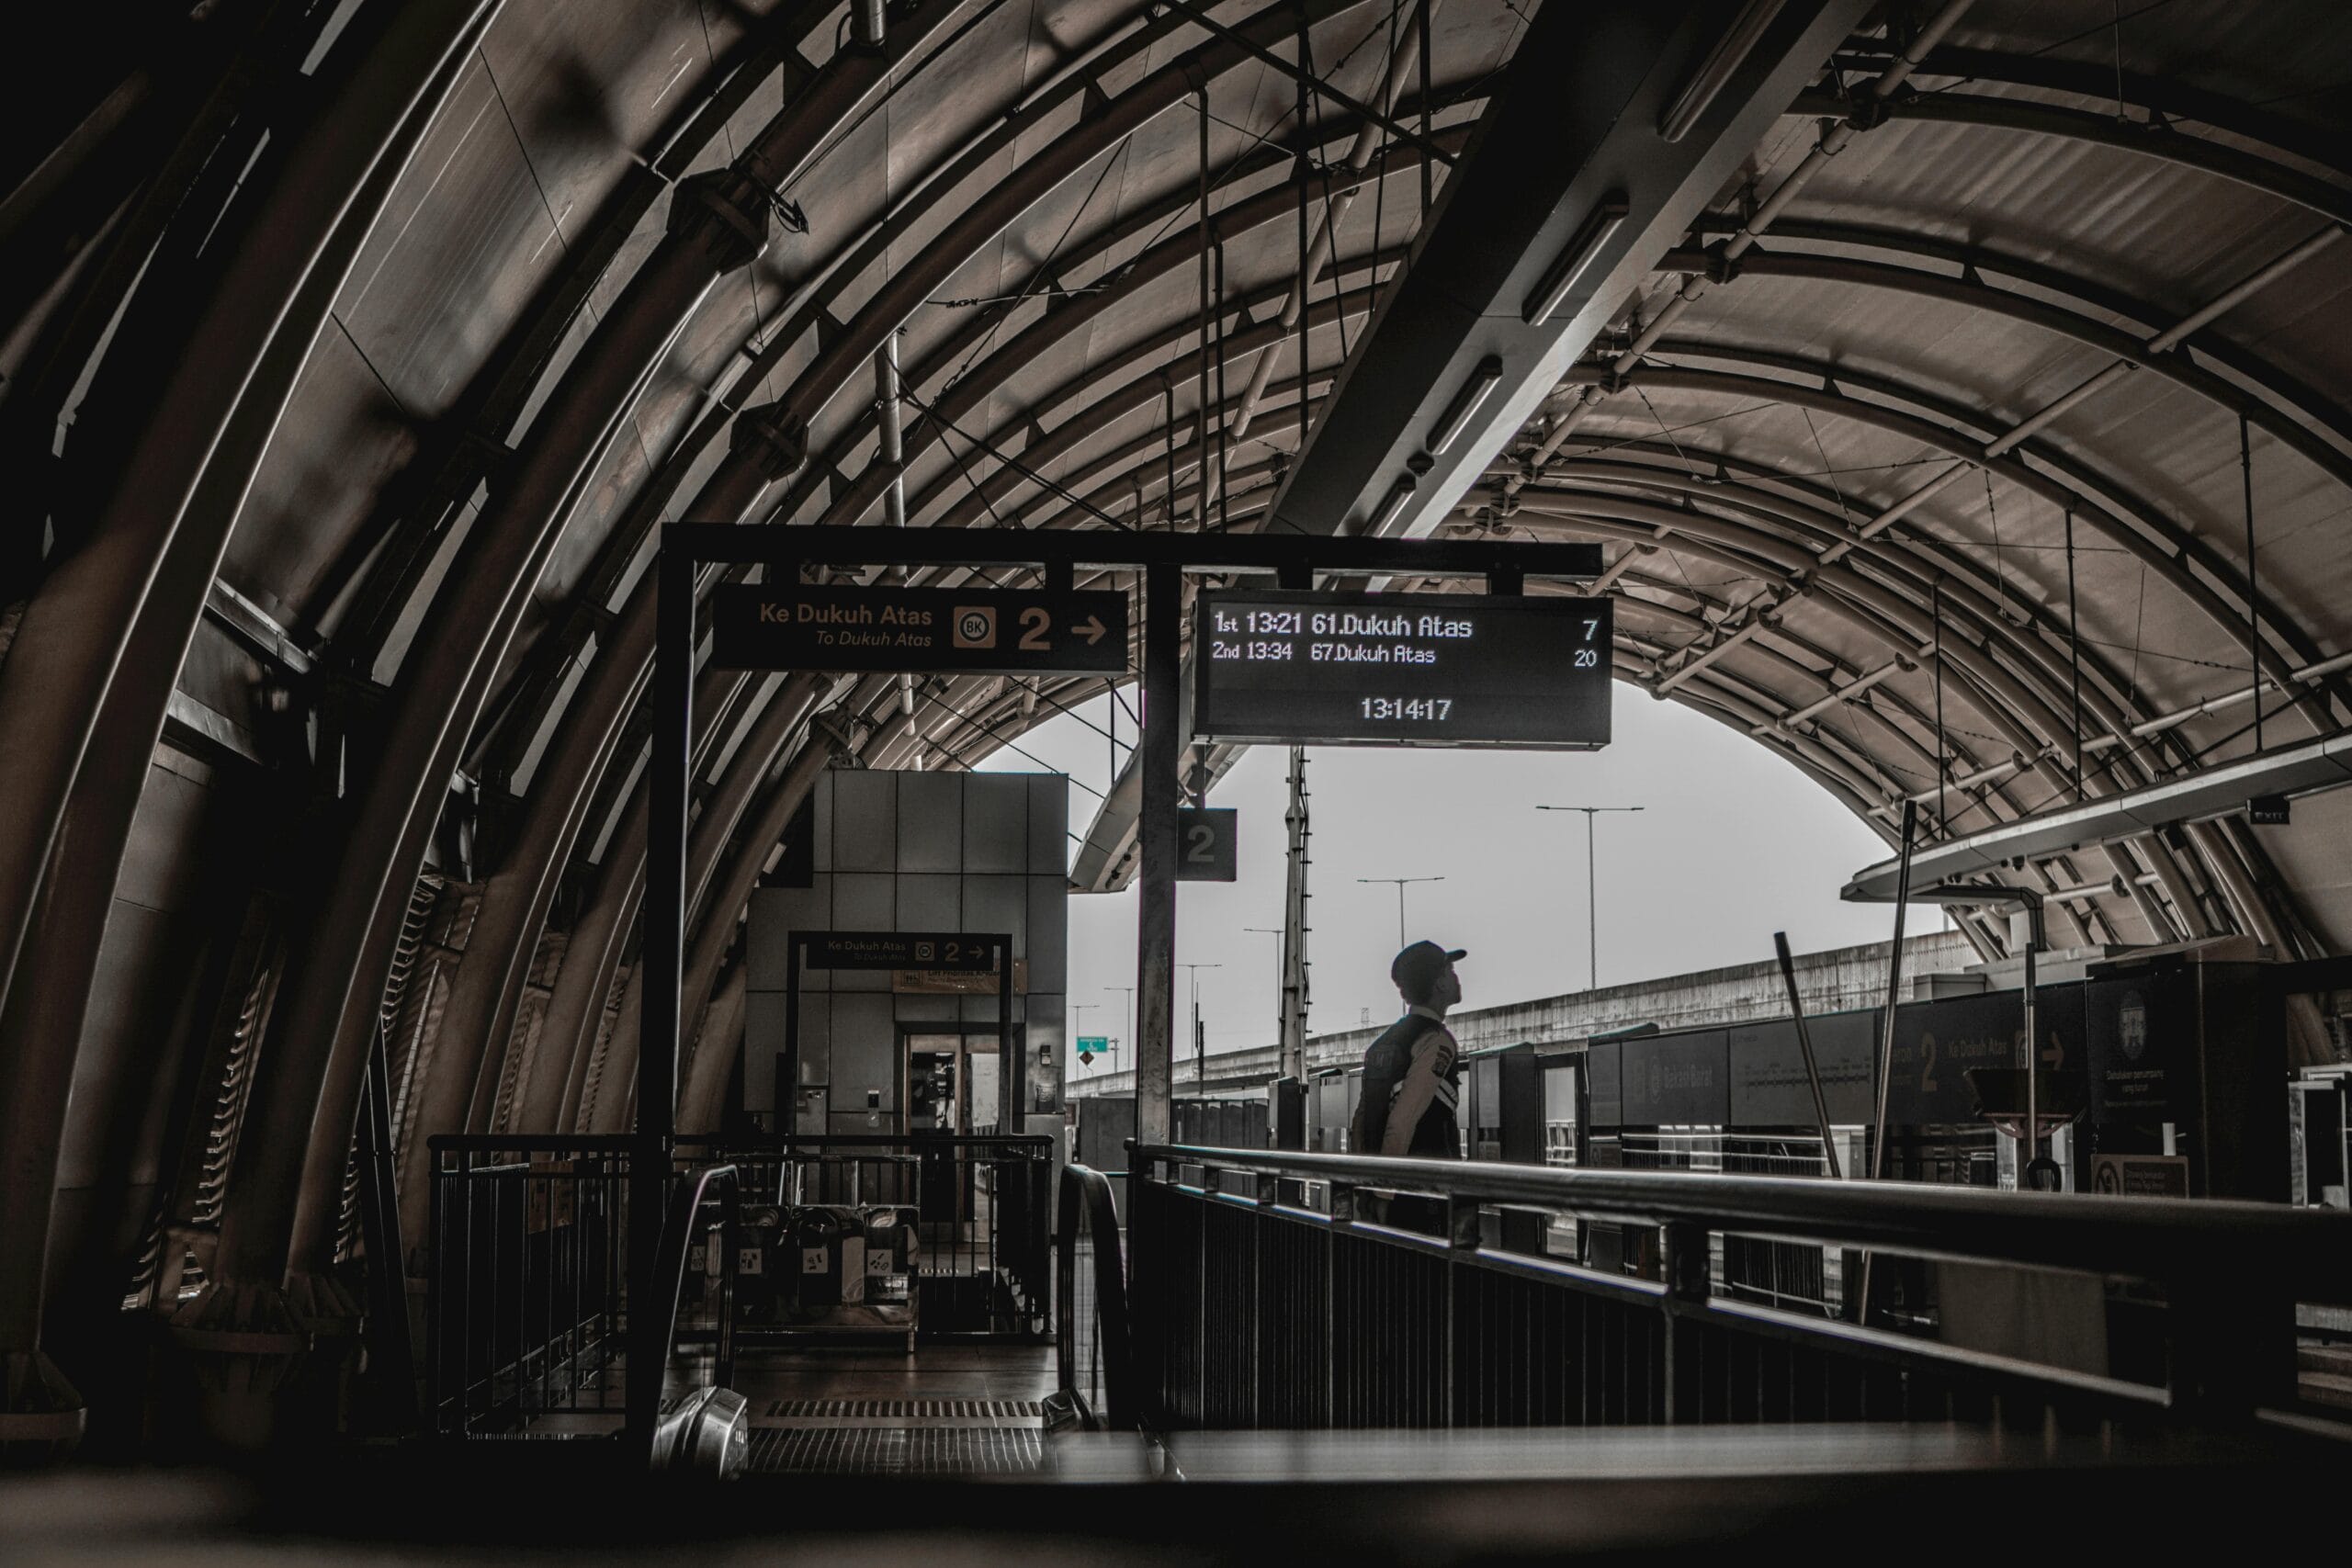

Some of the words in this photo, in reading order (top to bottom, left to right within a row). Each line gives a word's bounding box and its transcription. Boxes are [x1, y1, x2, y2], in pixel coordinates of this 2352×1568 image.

[759, 603, 790, 623] Ke
[797, 604, 872, 625] Dukuh
[880, 605, 933, 626] Atas
[1214, 611, 1238, 634] 1st
[1246, 611, 1301, 635] 13:21
[1418, 615, 1473, 638] Atas
[1582, 620, 1599, 641] 7
[816, 630, 834, 646] To
[839, 630, 890, 647] Dukuh
[894, 632, 933, 648] Atas
[965, 620, 983, 635] BK
[1017, 606, 1052, 651] 2
[1212, 642, 1240, 660] 2nd
[1246, 642, 1293, 661] 13:34
[1394, 645, 1436, 664] Atas
[1574, 649, 1598, 668] 20
[1361, 697, 1453, 721] 13:14:17
[1187, 824, 1216, 863] 2
[828, 941, 841, 951] Ke
[844, 941, 879, 951] Dukuh
[882, 942, 906, 952] Atas
[944, 942, 960, 963] 2
[1919, 1030, 1939, 1093] 2
